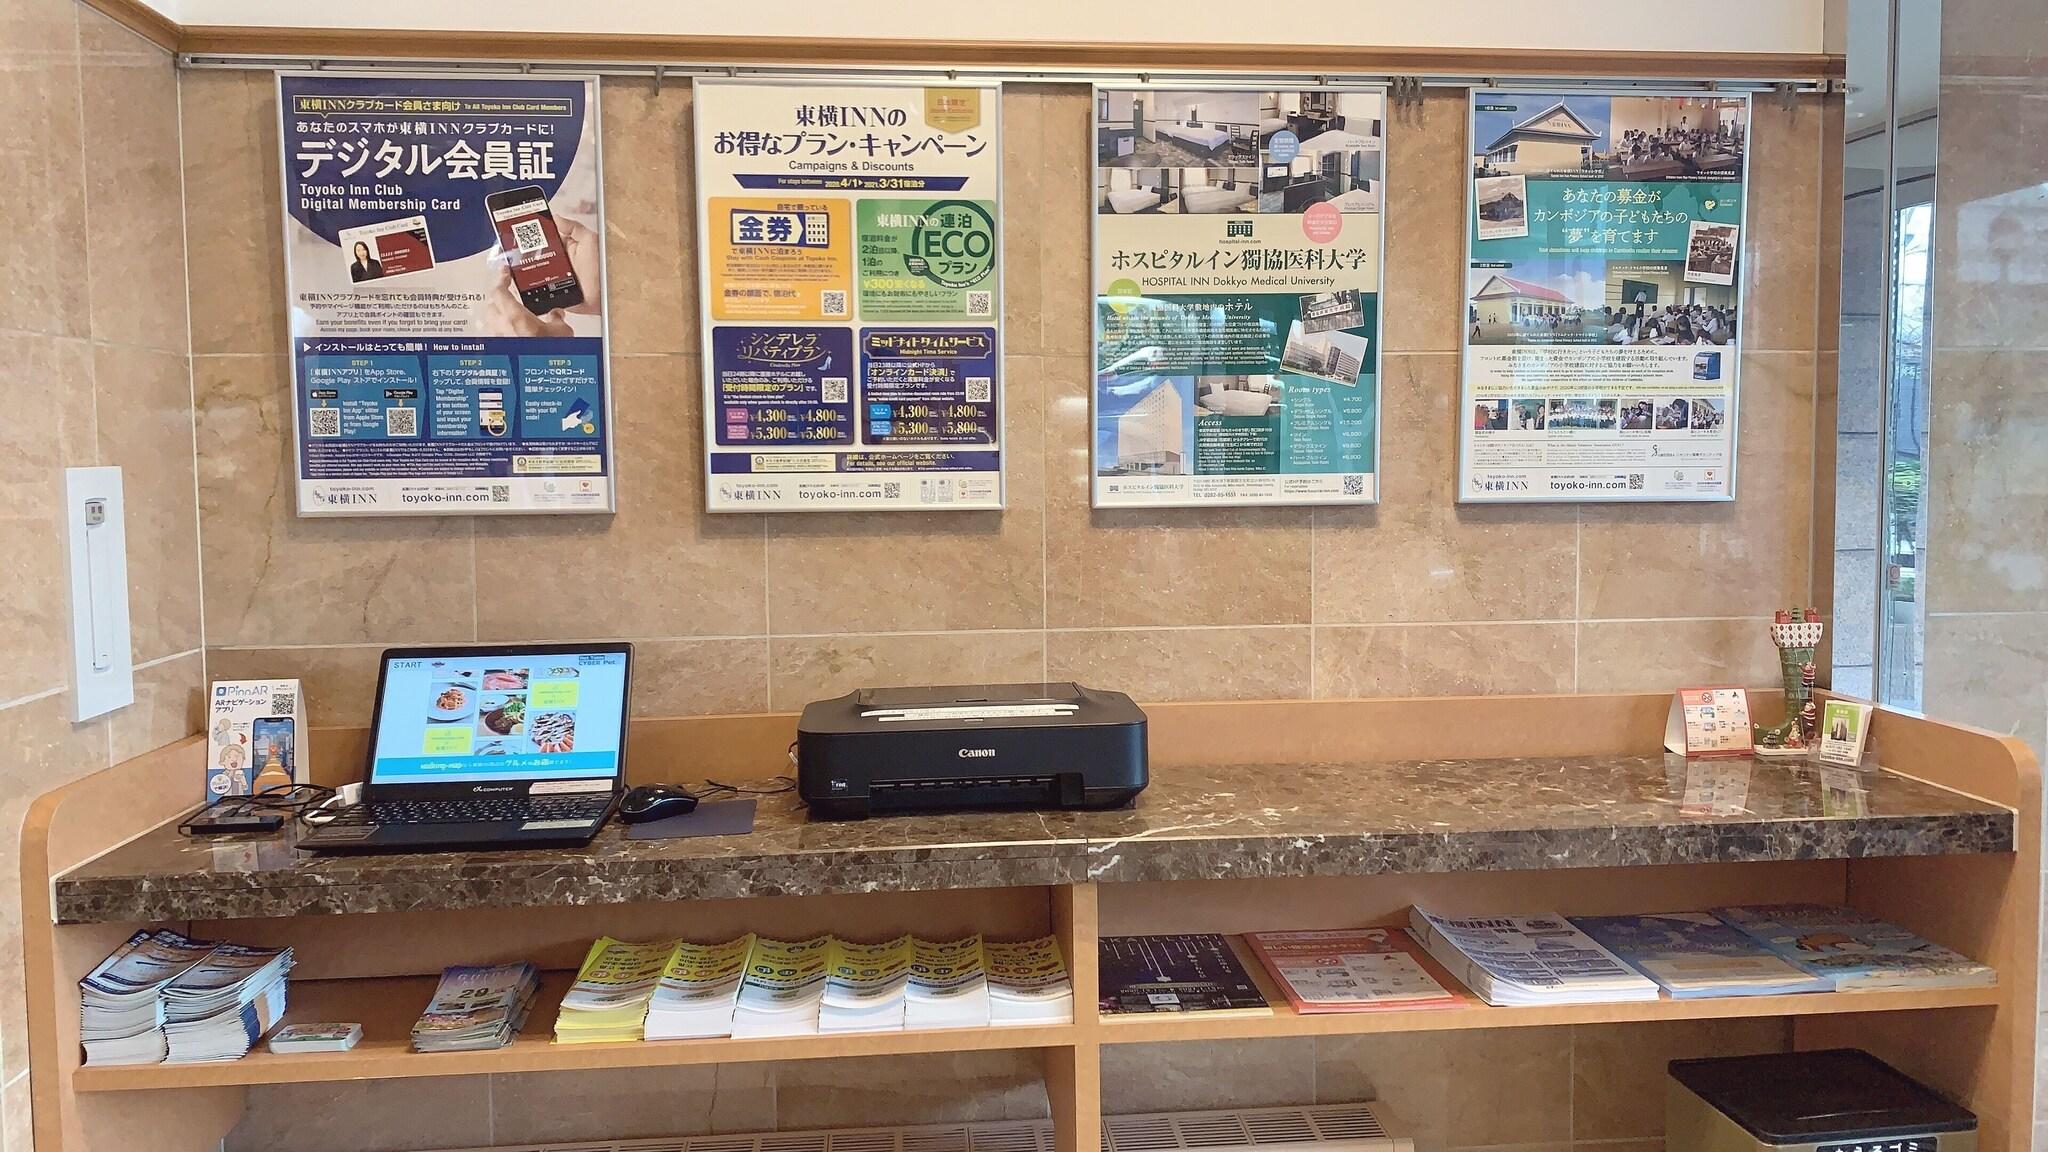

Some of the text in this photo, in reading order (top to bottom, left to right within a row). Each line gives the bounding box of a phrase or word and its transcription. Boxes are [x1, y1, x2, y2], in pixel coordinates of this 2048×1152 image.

[300, 98, 460, 112] 東横INNクラブカード会員さま向け
[796, 104, 906, 128] 東横INNの
[714, 131, 988, 158] お得なプラン・キャンペーン
[296, 137, 556, 181] デジタル会員証
[788, 160, 914, 173] Campaigns & Discounts
[300, 183, 402, 198] Toyoko Inn Club
[1562, 187, 1662, 206] あなたの募金が
[300, 197, 460, 212] Digital Membership Card
[877, 213, 972, 228] 東横INNの 連泊
[1534, 208, 1688, 226] カンボジアの子どもたちの
[738, 216, 792, 242] 金券
[924, 230, 990, 258] ECO
[1111, 248, 1366, 271] ホスピタルイン獨協医科大学
[938, 260, 978, 275] プラン
[1142, 276, 1336, 289] HOSPITAL INN Dokkyo Medical University
[750, 332, 818, 346] シンデレラ
[871, 336, 984, 348] ミッドナイトタイムサービス
[742, 346, 826, 359] リバティプラン
[750, 408, 837, 422] ¥4,300 ¥4,800
[892, 404, 977, 418] ¥4,300 ¥4,800
[750, 426, 837, 440] ¥5,300 ¥5,800
[893, 422, 977, 434] ¥5,300 ¥5,800
[1484, 480, 1529, 491] 東横INN
[1550, 480, 1627, 491] toyoko-inn.com
[328, 494, 377, 504] 東横INN
[402, 492, 490, 504] toyoko-inn.com
[734, 490, 782, 500] 東横INN
[800, 488, 882, 500] toyoko-inn.com
[394, 661, 422, 670] START
[216, 706, 234, 714] アプリ
[958, 748, 996, 759] Canon
